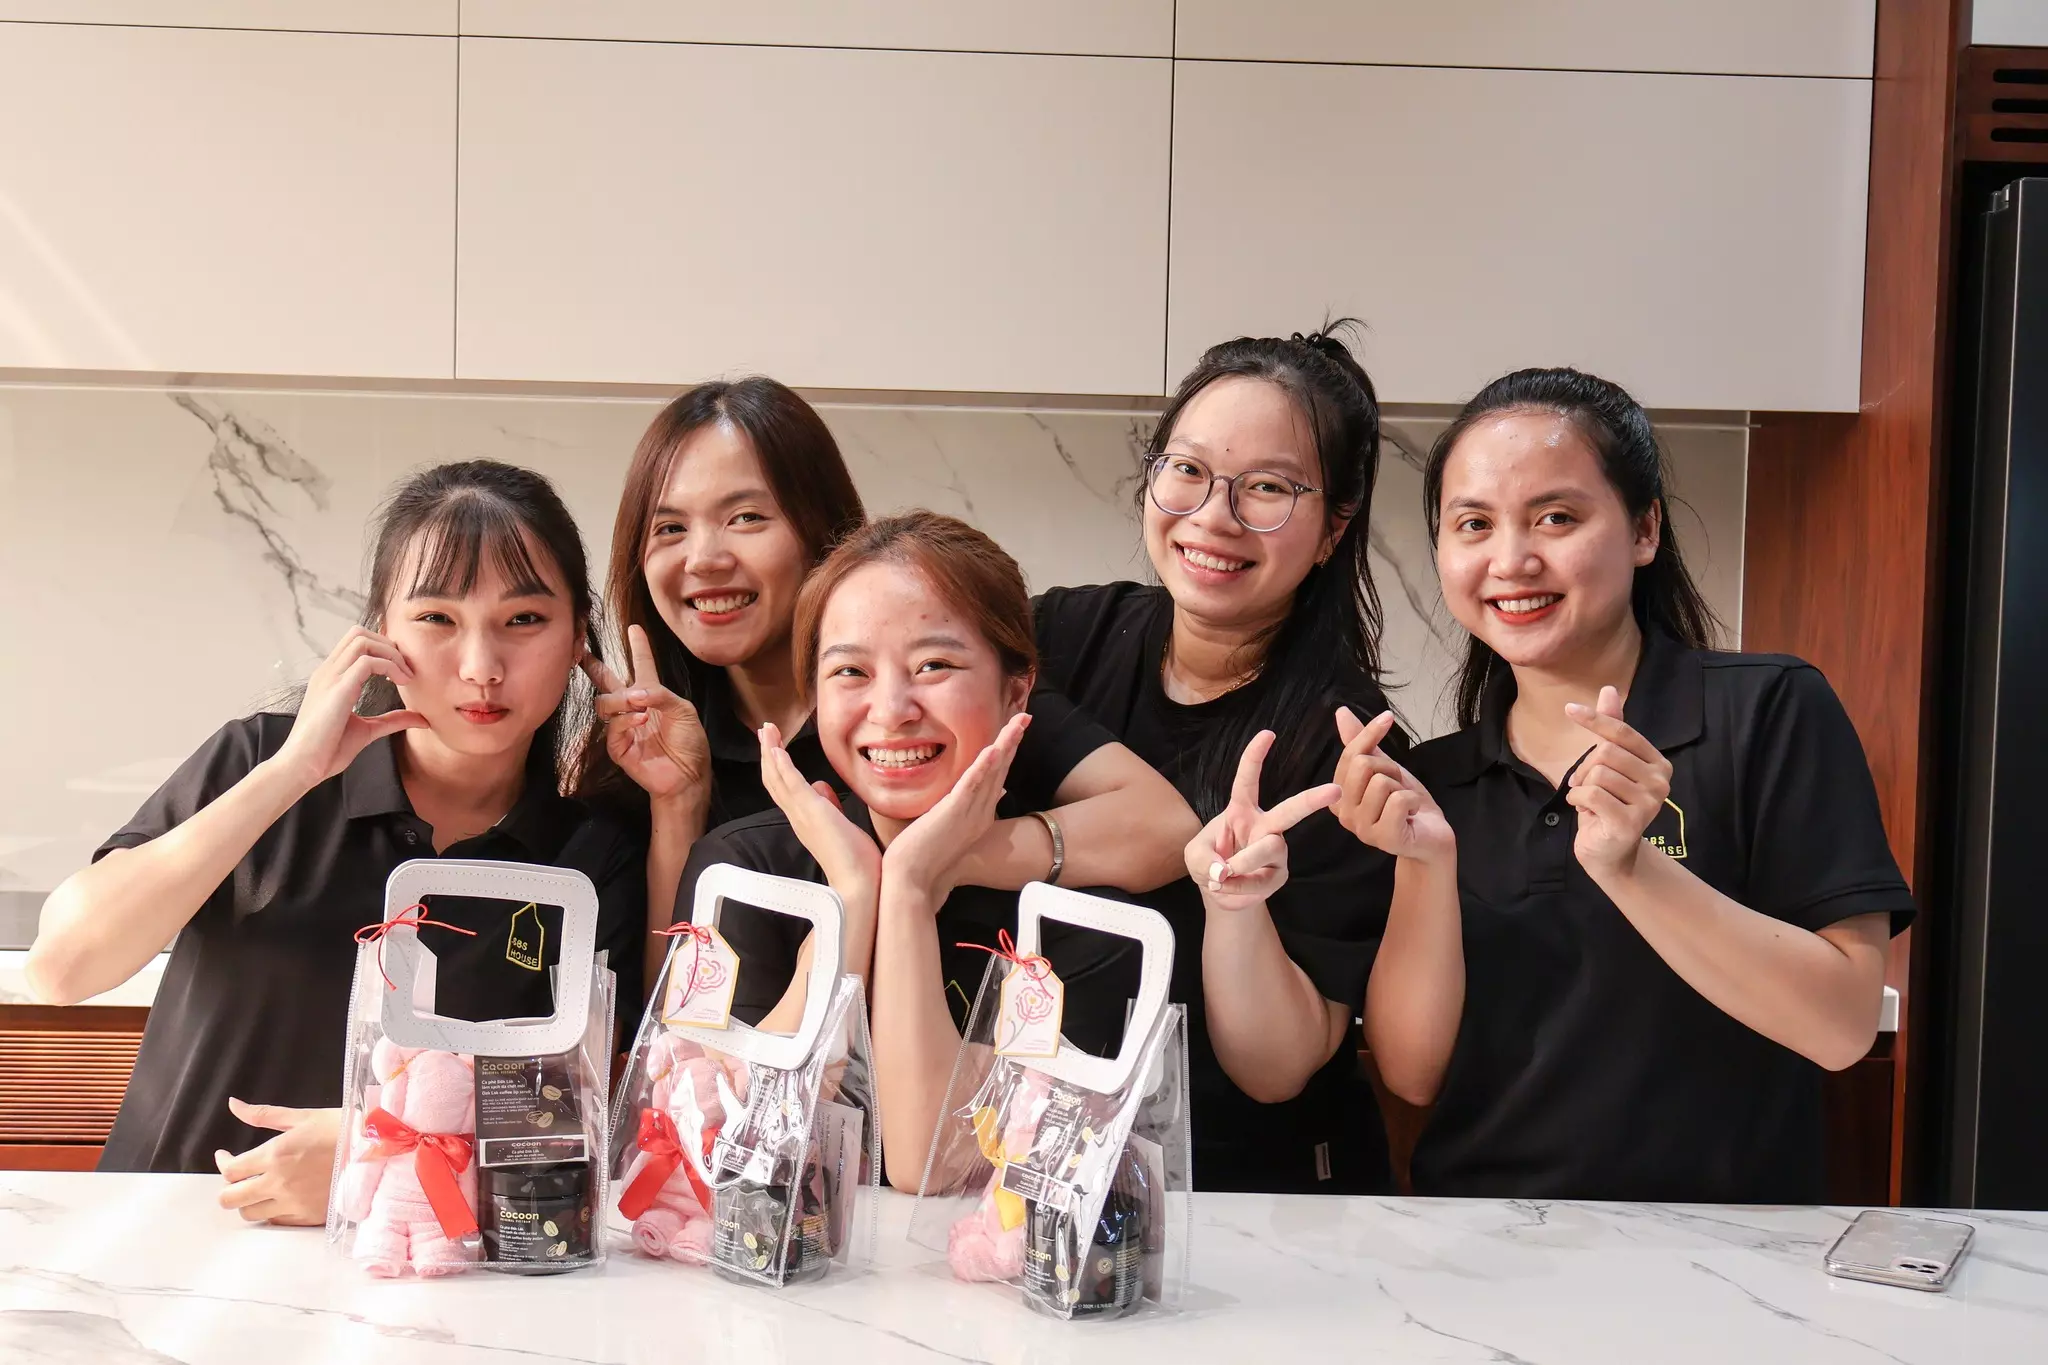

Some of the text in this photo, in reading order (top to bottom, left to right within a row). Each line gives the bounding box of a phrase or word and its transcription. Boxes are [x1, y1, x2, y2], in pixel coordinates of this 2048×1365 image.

[1645, 835, 1665, 845] BS
[1659, 846, 1682, 855] USE
[510, 948, 538, 966] HOUSE
[482, 1063, 525, 1071] cocoon
[500, 1210, 539, 1220] cocoon
